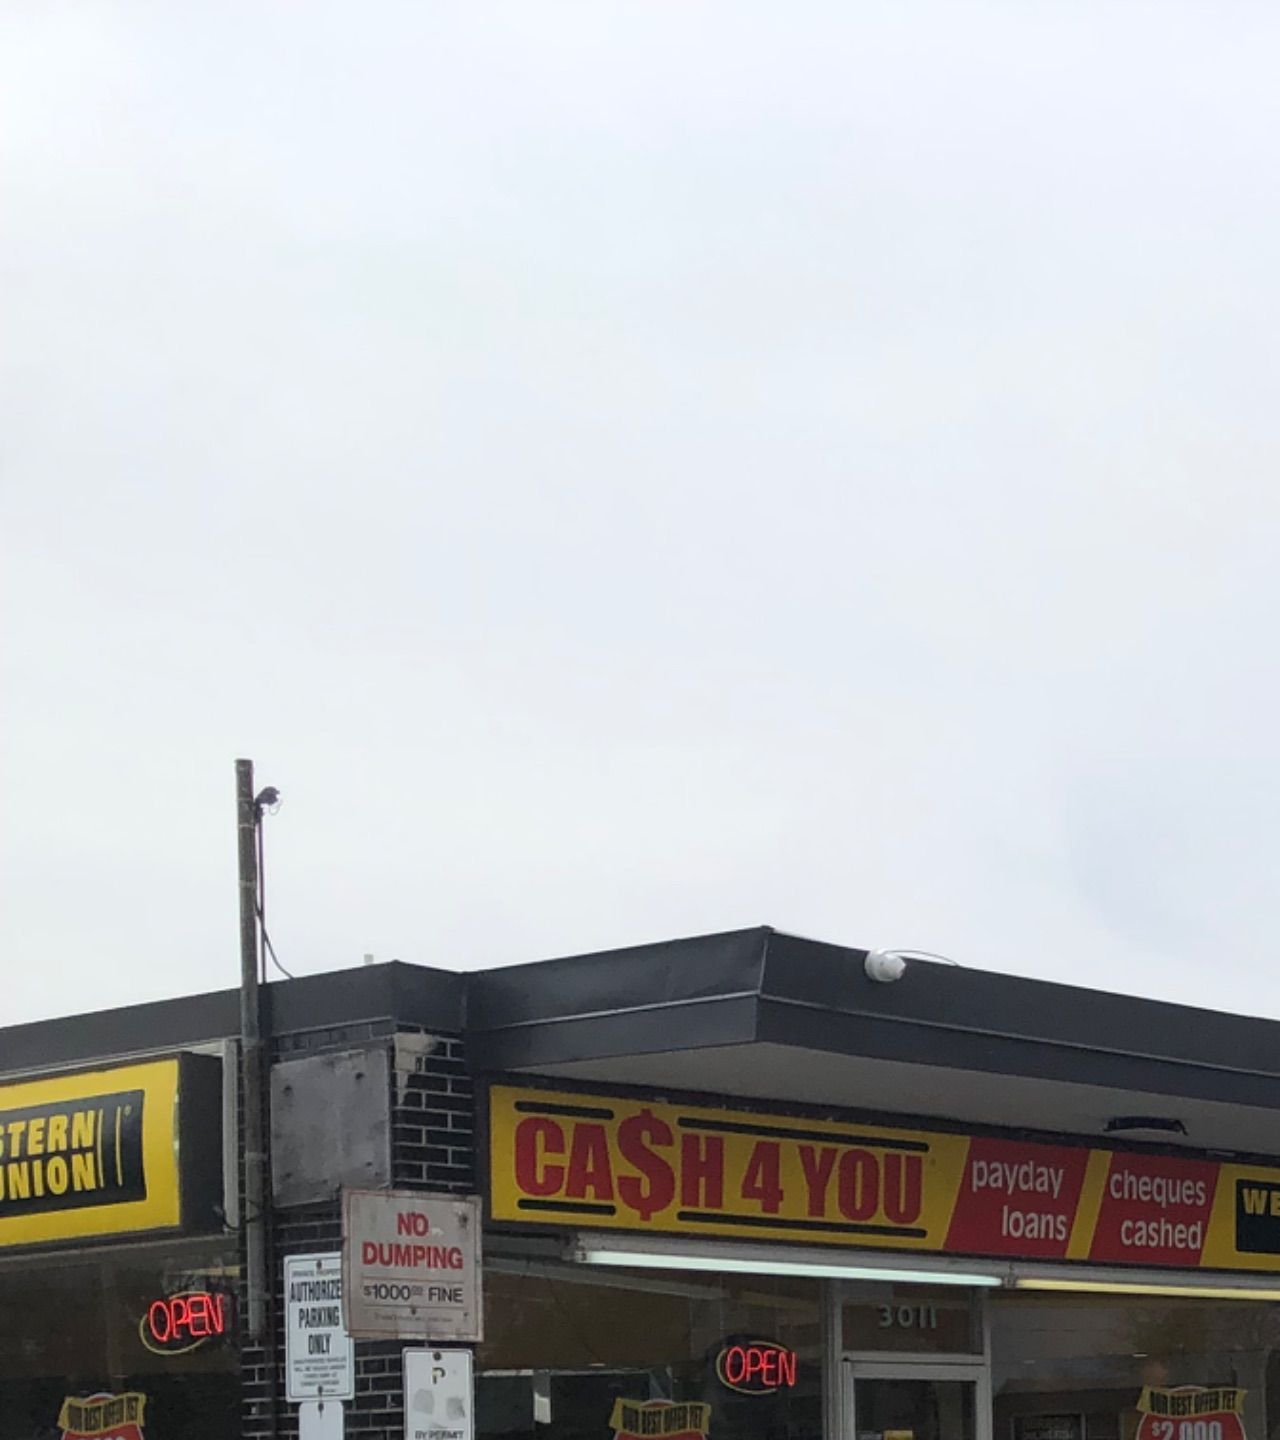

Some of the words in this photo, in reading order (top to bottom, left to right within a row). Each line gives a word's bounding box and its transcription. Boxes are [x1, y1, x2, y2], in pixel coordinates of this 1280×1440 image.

[0, 1110, 95, 1158] TERN
[514, 1108, 725, 1221] CA$H
[741, 1140, 784, 1214] 4
[797, 1143, 923, 1224] YOU
[972, 1159, 1064, 1199] payday
[1110, 1169, 1206, 1208] cheques
[396, 1212, 429, 1237] NO
[1002, 1205, 1067, 1241] loans
[1121, 1218, 1202, 1249] cashed
[362, 1241, 463, 1270] DUMPING
[428, 1287, 463, 1303] FINE
[149, 1293, 223, 1342] OPEN
[299, 1306, 340, 1328] PARKING
[878, 1303, 938, 1330] 3011
[308, 1333, 332, 1355] ONLY
[724, 1346, 796, 1387] OPEN
